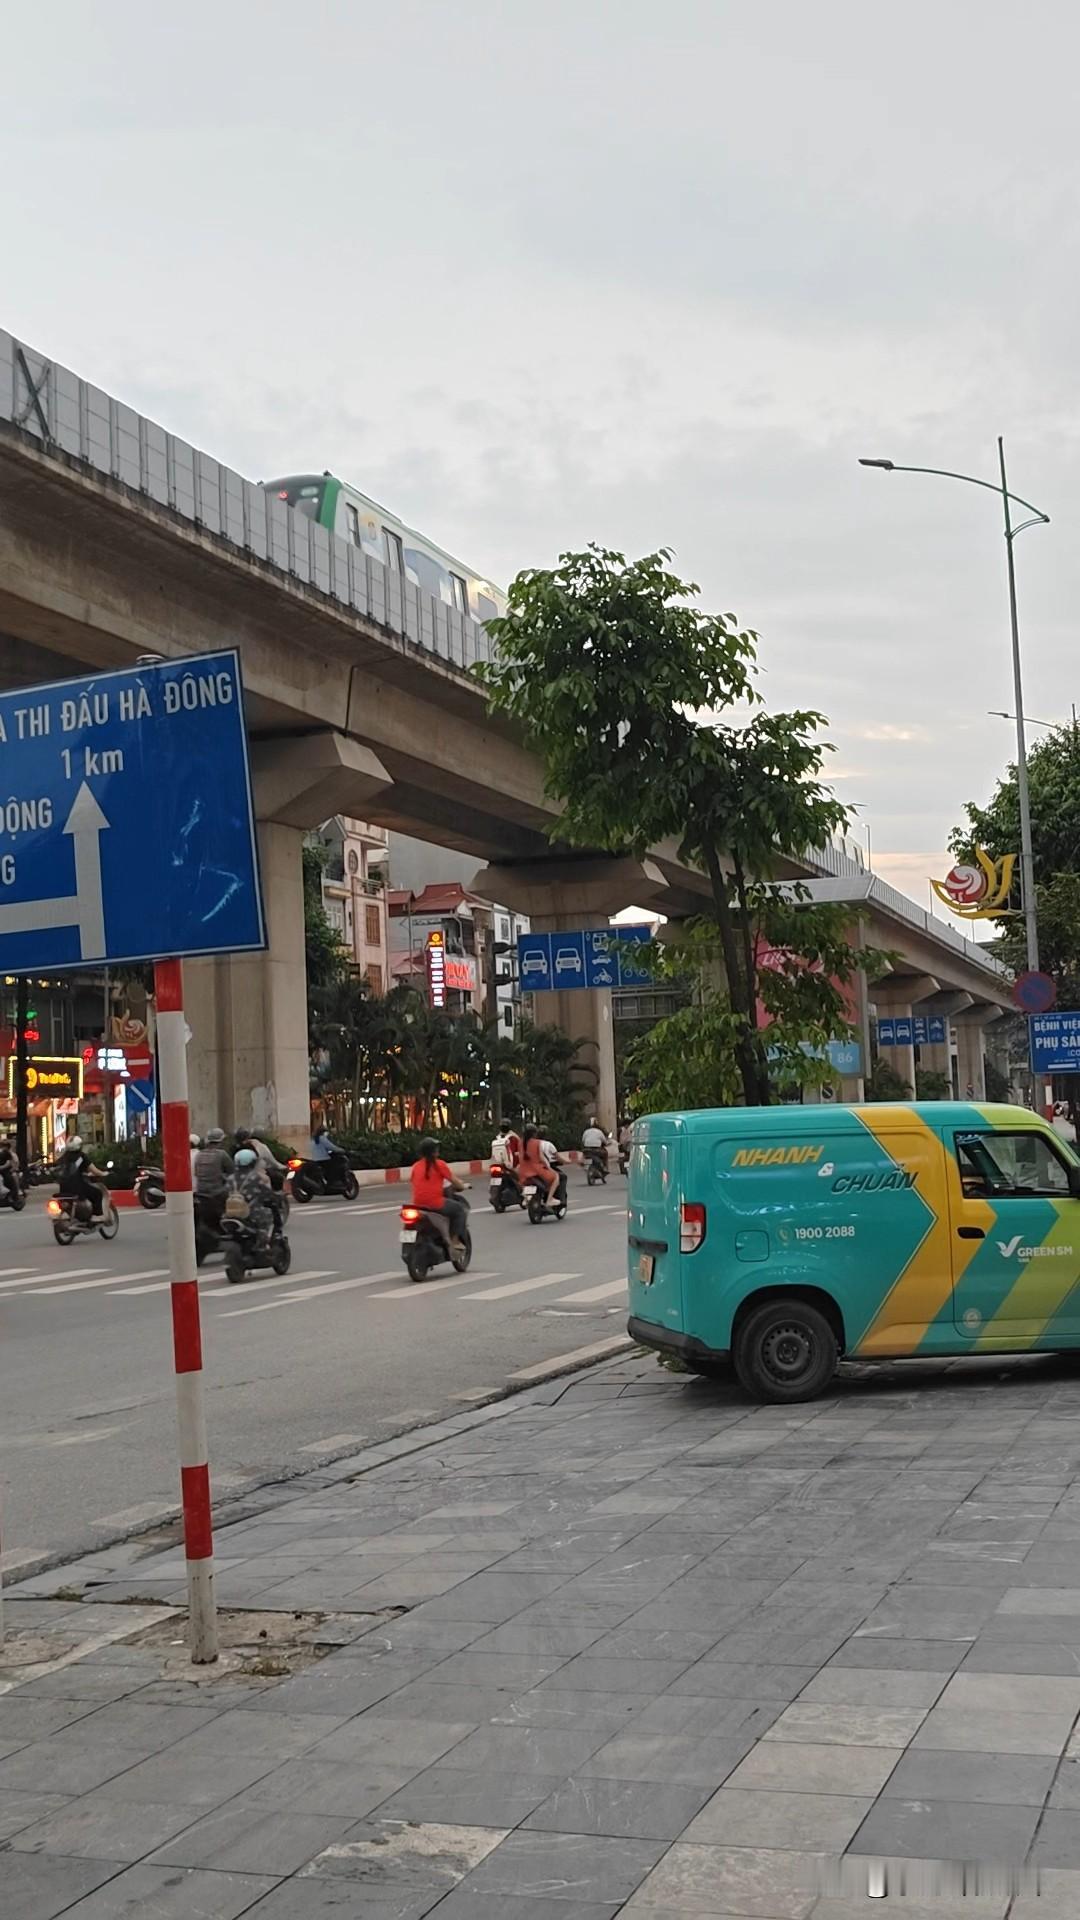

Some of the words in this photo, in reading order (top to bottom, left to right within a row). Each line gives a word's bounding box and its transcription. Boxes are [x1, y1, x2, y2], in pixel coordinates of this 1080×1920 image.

[14, 705, 50, 740] THI
[60, 683, 109, 732] ĐẤU
[119, 678, 152, 722] HÀ
[164, 672, 233, 713] ĐÔNG
[60, 748, 71, 780] 1
[84, 745, 124, 777] km
[0, 854, 16, 885] G
[1034, 1020, 1060, 1033] BỆNH
[1035, 1037, 1059, 1051] PHỤ
[732, 1145, 824, 1167] NHANH
[831, 1164, 918, 1194] CHUẨN
[795, 1228, 823, 1240] 1900
[825, 1226, 855, 1239] 2088
[1017, 1246, 1055, 1257] GREEN
[1055, 1246, 1073, 1255] SM
